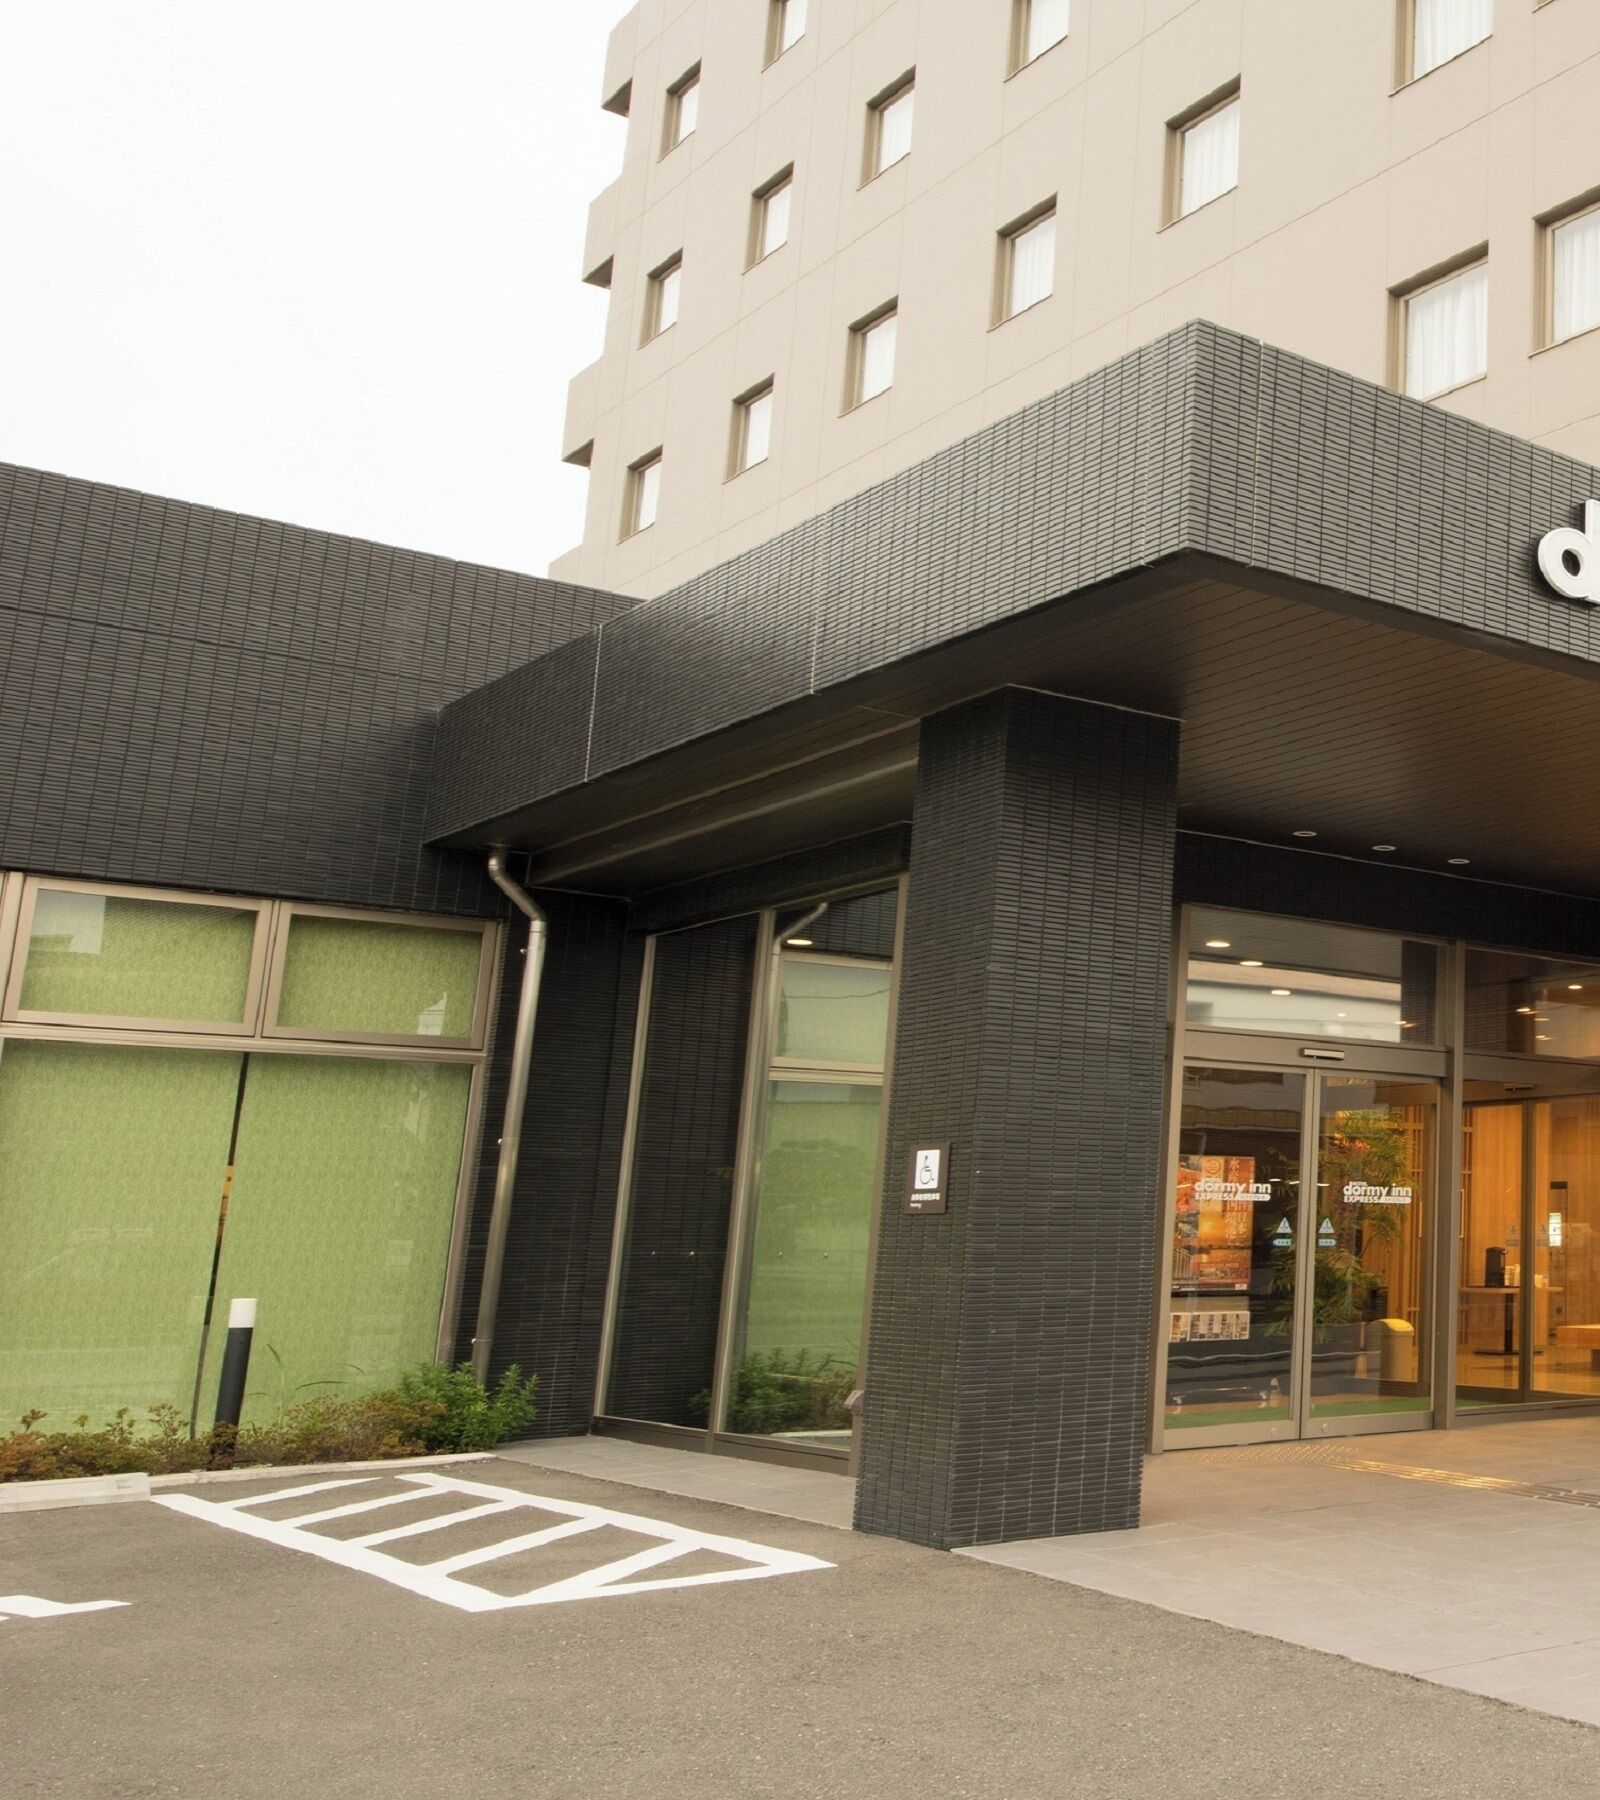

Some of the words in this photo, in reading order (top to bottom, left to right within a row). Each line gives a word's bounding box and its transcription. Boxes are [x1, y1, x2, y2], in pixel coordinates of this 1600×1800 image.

[1194, 1178, 1247, 1197] dormy
[1249, 1179, 1271, 1194] inn
[1343, 1181, 1389, 1199] dormy
[1391, 1182, 1412, 1196] inn
[1195, 1193, 1235, 1201] EXPRESS
[1344, 1195, 1379, 1203] EXPRESS
